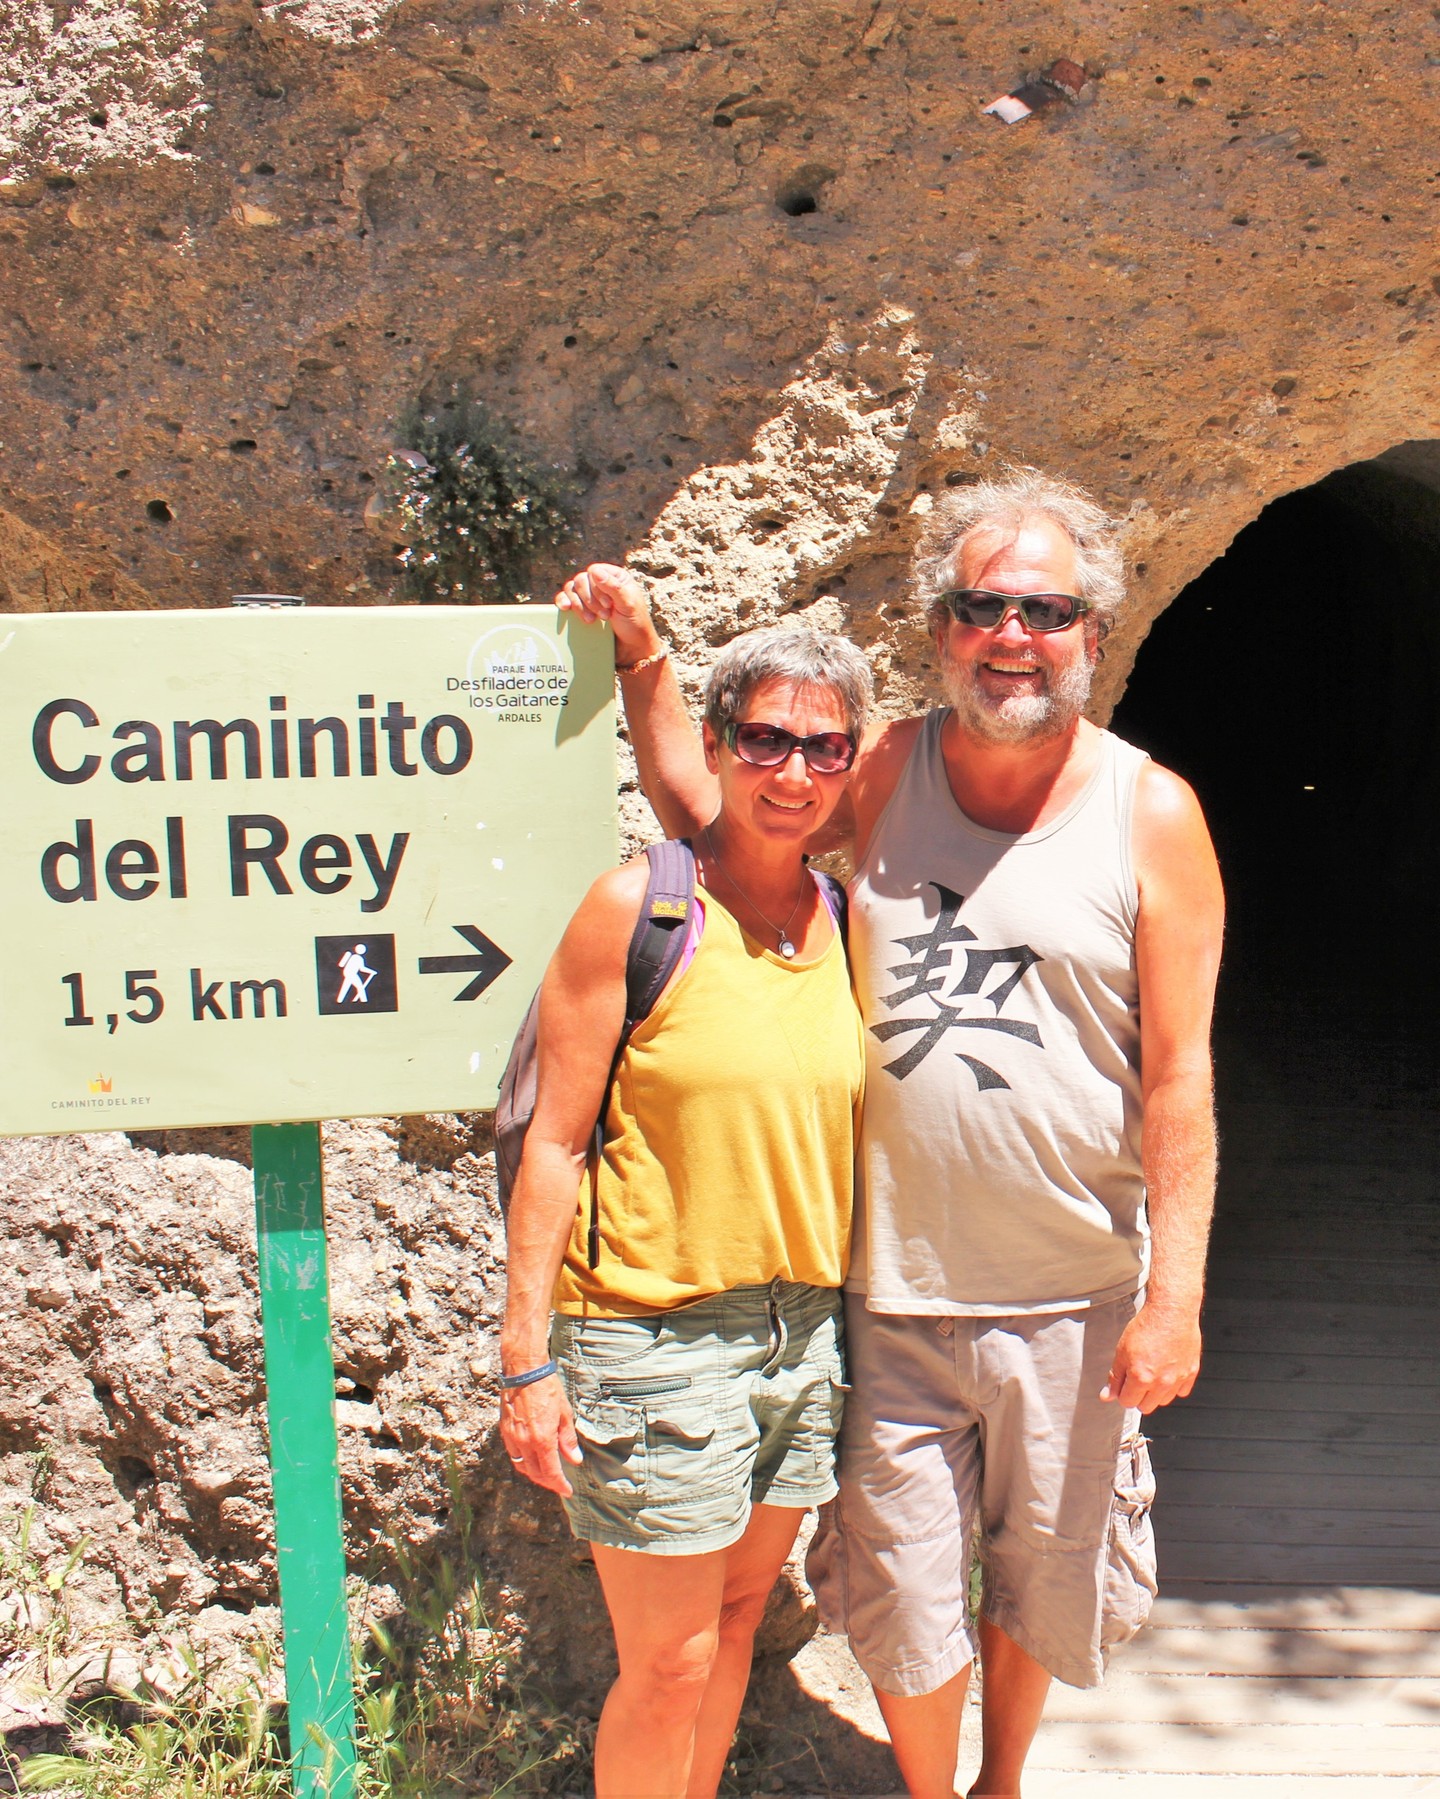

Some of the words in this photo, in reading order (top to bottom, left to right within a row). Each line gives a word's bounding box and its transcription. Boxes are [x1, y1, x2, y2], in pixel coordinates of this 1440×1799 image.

[492, 665, 525, 673] PARAJE
[529, 664, 568, 673] NATURAL
[447, 676, 545, 691] Desfiladero
[547, 676, 568, 689] de
[469, 695, 493, 708] los
[496, 694, 569, 707] Gaitanes
[498, 713, 542, 723] ARDALES
[32, 694, 474, 785] Caminito
[40, 816, 188, 904] del
[227, 813, 410, 913] Rey
[61, 969, 165, 1035] 1,5
[190, 967, 288, 1022] km
[51, 1099, 104, 1109] CAMINITO
[107, 1098, 128, 1106] DEL
[130, 1097, 151, 1105] REY
